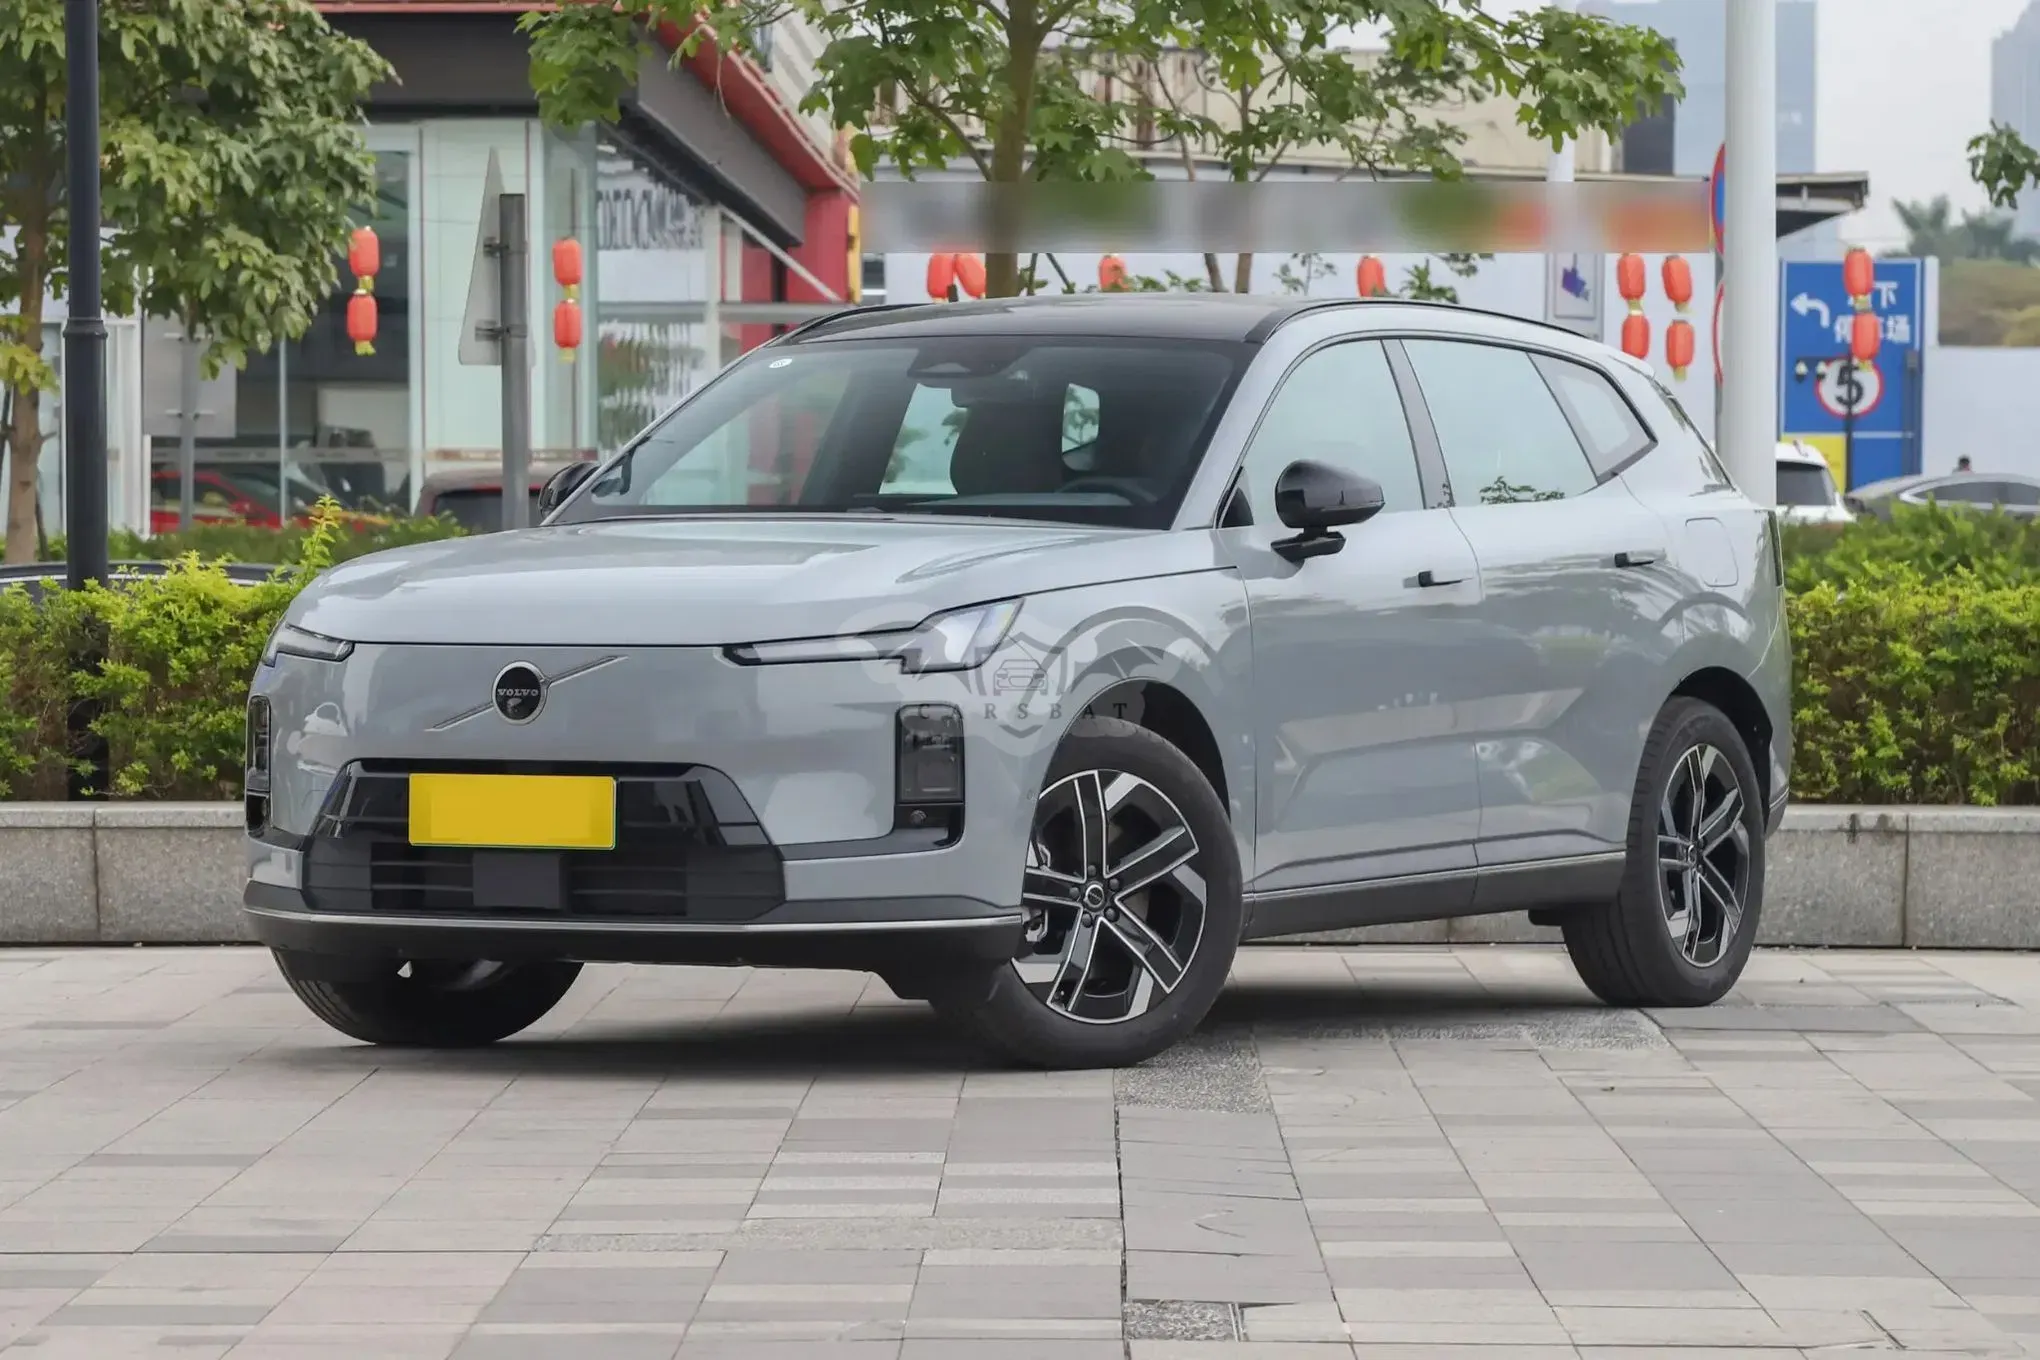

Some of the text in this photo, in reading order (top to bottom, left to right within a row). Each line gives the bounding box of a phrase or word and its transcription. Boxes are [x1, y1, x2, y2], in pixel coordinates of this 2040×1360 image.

[1834, 315, 1911, 343] 停场
[1836, 365, 1864, 407] 5
[497, 688, 539, 697] VOLVO
